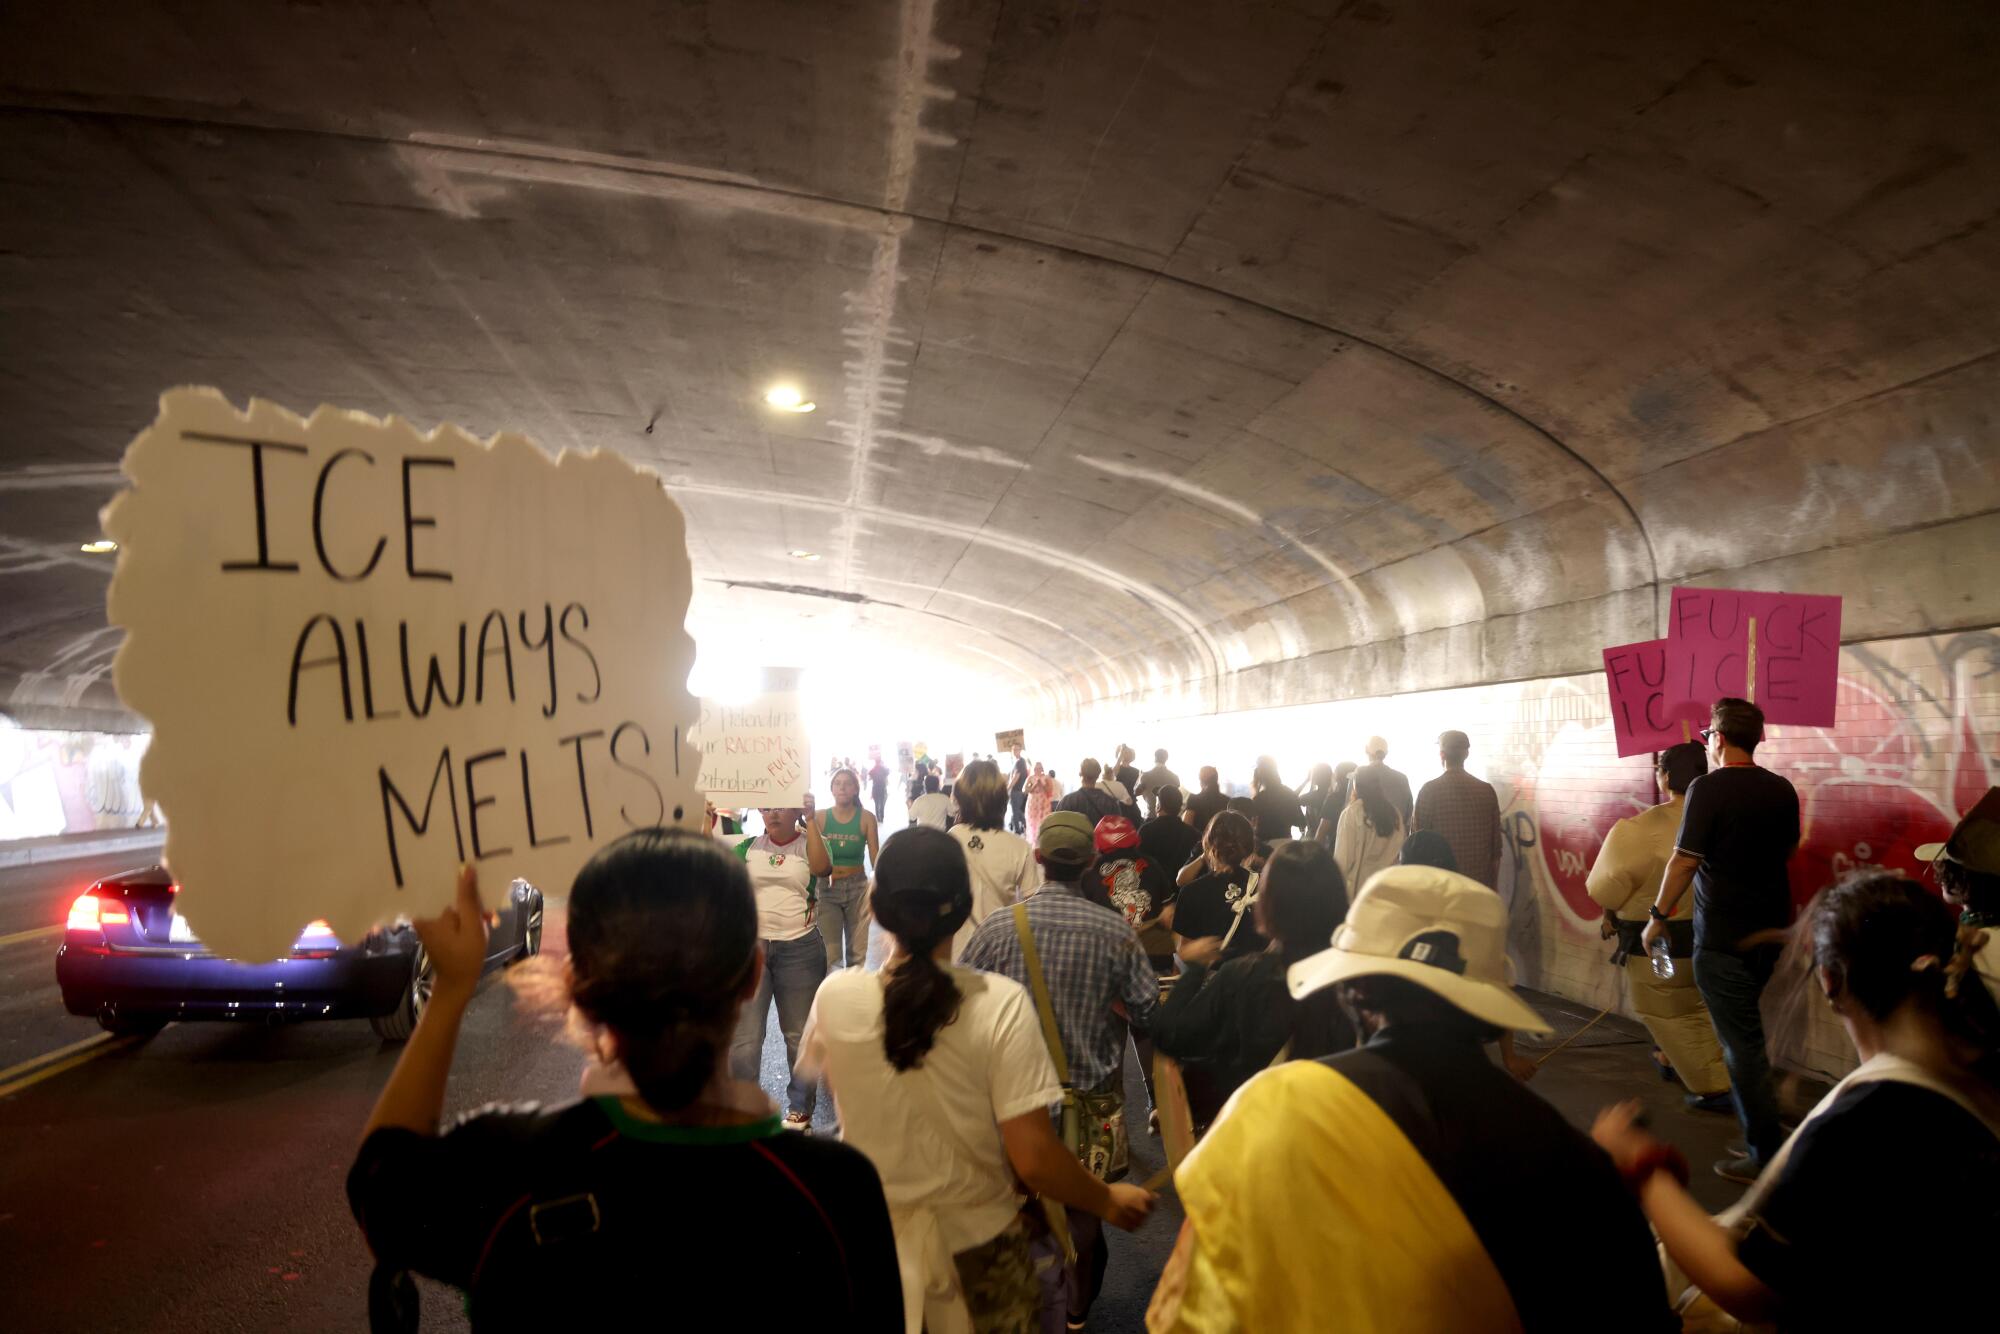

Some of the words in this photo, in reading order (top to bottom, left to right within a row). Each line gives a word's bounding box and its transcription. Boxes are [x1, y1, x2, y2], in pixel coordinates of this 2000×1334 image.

[181, 431, 456, 582] ICE
[288, 602, 602, 726] ALWAYS
[1676, 595, 1830, 654] FUCK
[1688, 652, 1802, 701] ICE
[725, 736, 782, 755] RACISM
[379, 721, 683, 889] MELTS!
